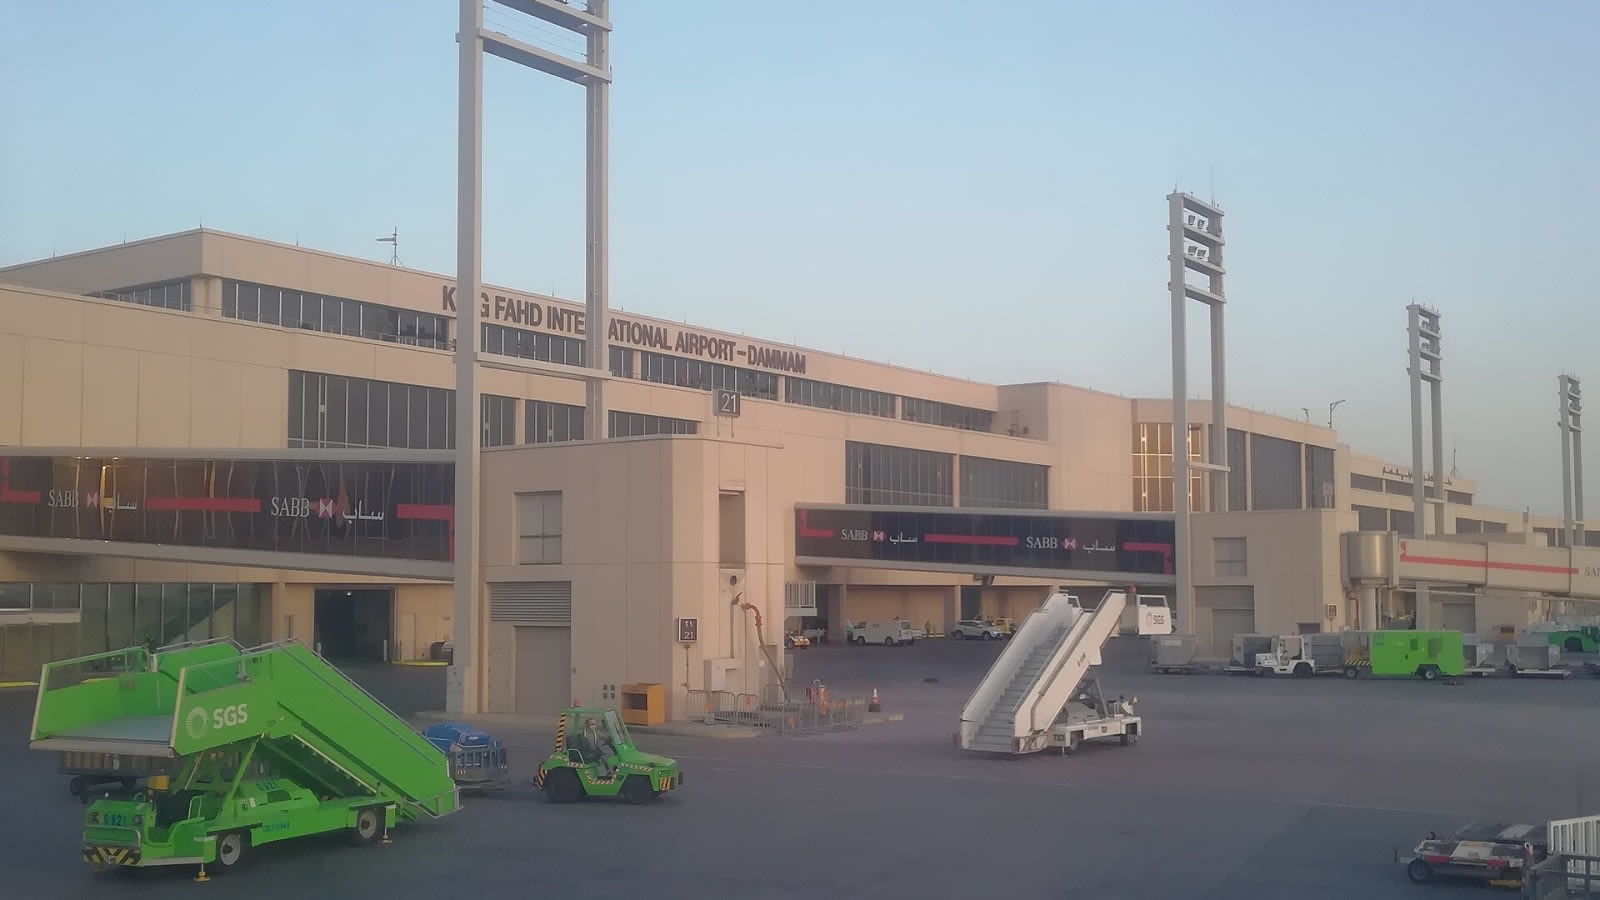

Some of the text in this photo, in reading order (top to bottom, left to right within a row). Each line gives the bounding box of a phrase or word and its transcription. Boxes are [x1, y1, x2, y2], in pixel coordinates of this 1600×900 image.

[442, 285, 490, 318] KG
[494, 295, 543, 327] FAHD
[546, 305, 672, 351] INTEATIONAL
[721, 392, 737, 413] 21
[271, 496, 310, 518] SABB
[342, 499, 385, 525] ساب
[840, 528, 868, 541] SABB
[889, 531, 918, 545] ساب
[1026, 536, 1058, 549] SABB
[1082, 539, 1116, 553] ساب
[684, 631, 694, 640] 21
[213, 703, 248, 730] SGS
